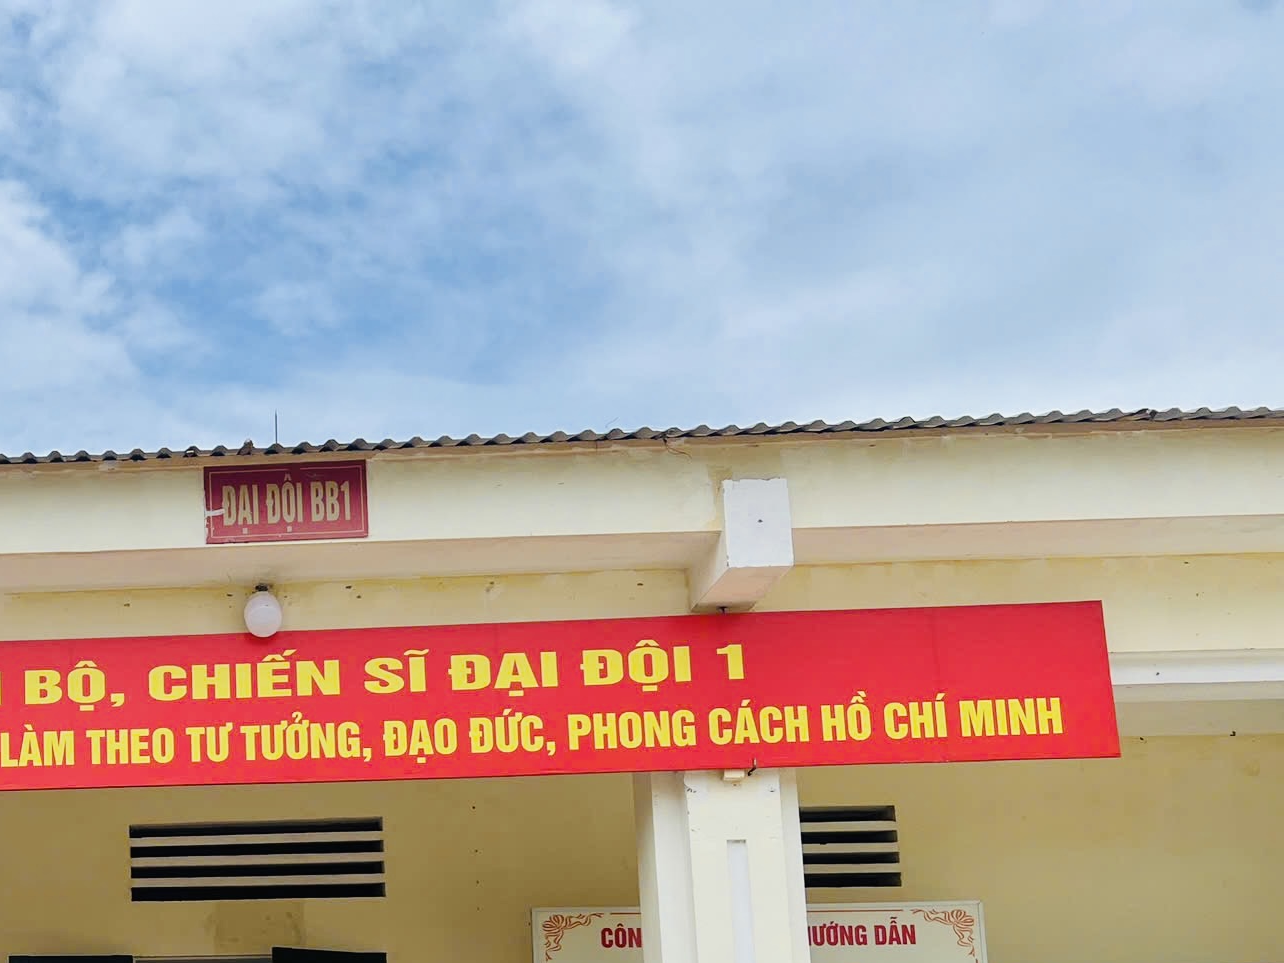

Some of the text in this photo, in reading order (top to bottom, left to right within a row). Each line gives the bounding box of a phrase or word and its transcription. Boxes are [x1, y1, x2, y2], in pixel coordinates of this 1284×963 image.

[222, 473, 351, 534] ĐẠI ĐỘI BB1
[24, 660, 125, 712] BỘ,
[148, 649, 341, 702] CHIẾN
[364, 649, 427, 694] SĨ
[448, 651, 559, 697] ĐẠI
[580, 639, 692, 692] ĐỘI
[717, 644, 745, 680] 1
[0, 723, 75, 768] LÀM
[86, 727, 175, 765] THEO
[186, 721, 233, 762] TƯ
[239, 711, 372, 765] TƯỞNG,
[383, 717, 458, 766] ĐẠO
[468, 708, 556, 757] ĐỨC,
[567, 709, 697, 751] PHONG
[709, 701, 809, 746] CÁCH
[820, 690, 872, 742] HỒ
[884, 692, 948, 740] CHÍ
[959, 697, 1064, 738] MINH
[874, 917, 917, 946] DẪN
